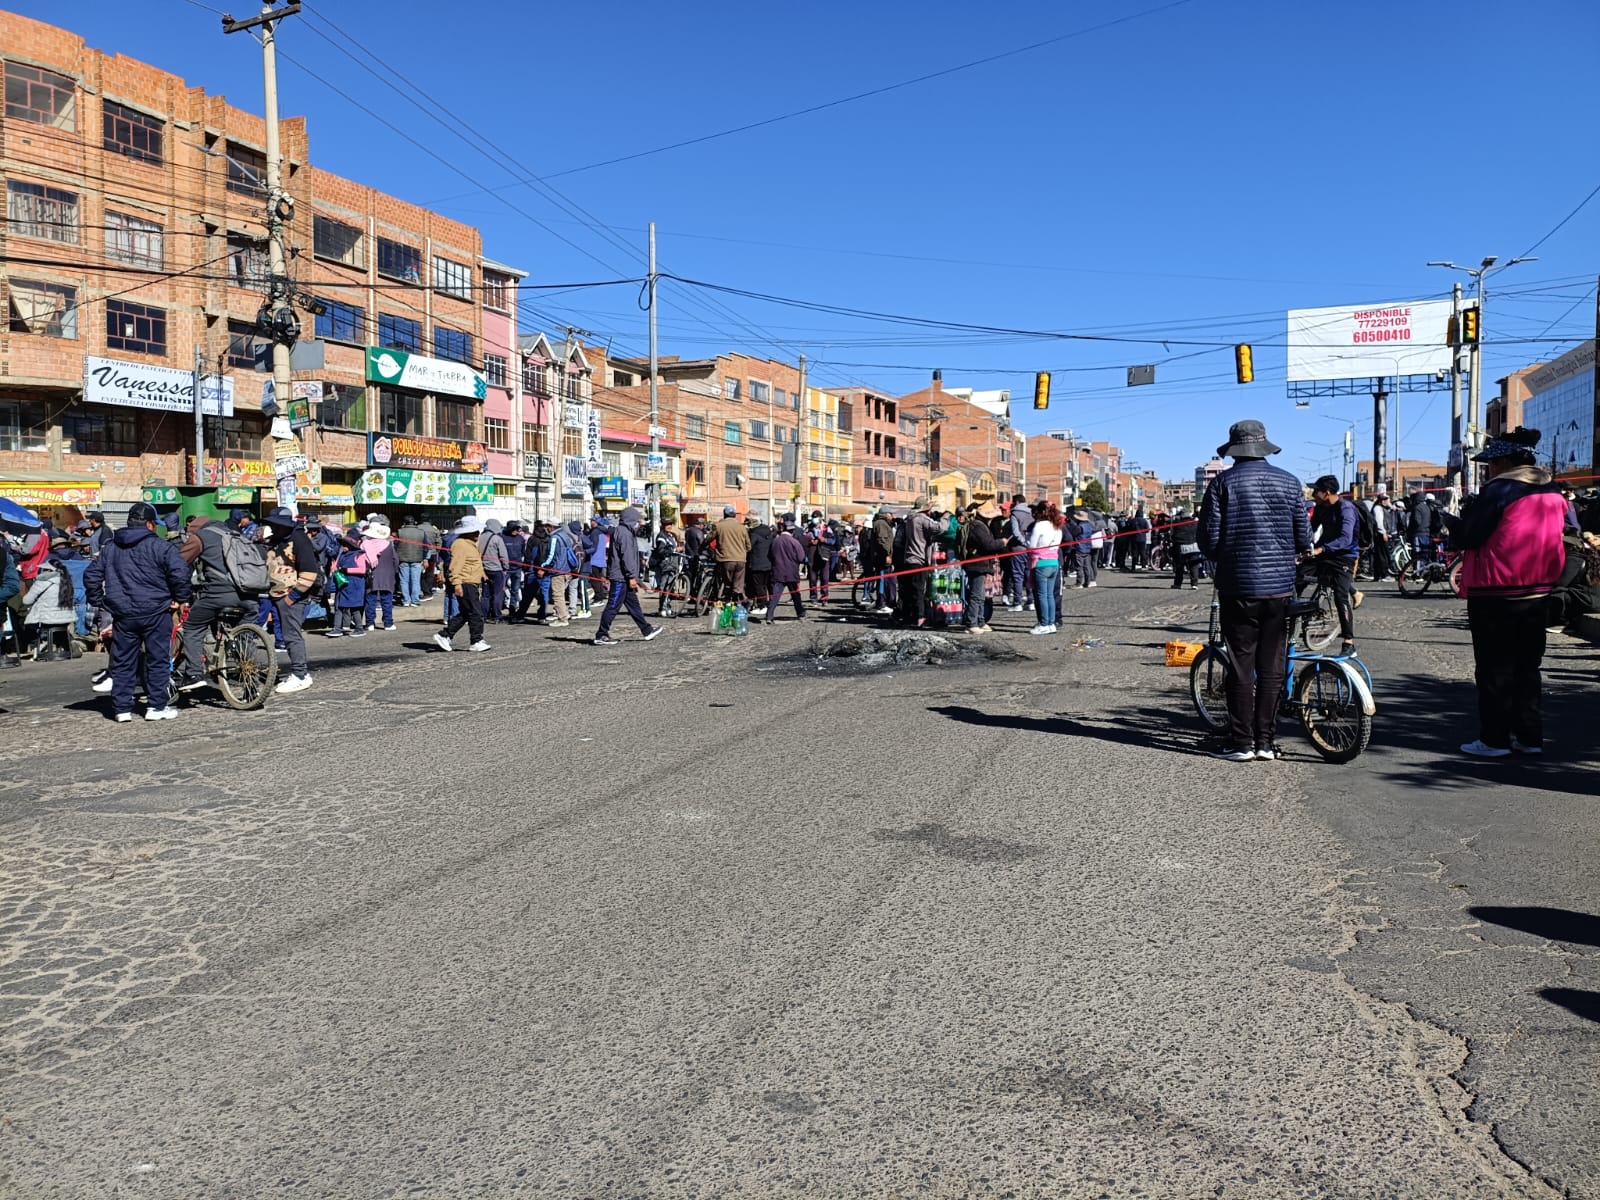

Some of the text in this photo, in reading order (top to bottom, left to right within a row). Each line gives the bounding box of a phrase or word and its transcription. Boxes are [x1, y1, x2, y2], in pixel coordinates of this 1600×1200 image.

[1354, 308, 1411, 319] DISPONIBLE
[1358, 317, 1407, 328] 77229109
[1353, 329, 1411, 343] 60500410
[409, 364, 428, 376] MAR
[92, 366, 194, 397] Vanessa
[128, 391, 195, 405] Estilism
[588, 416, 597, 462] FARMACIA
[392, 437, 424, 457] POLLOS
[443, 441, 462, 459] LEÑA
[398, 457, 430, 465] CHICKEN
[433, 459, 456, 468] HOUSE
[526, 455, 553, 468] DENTSTA
